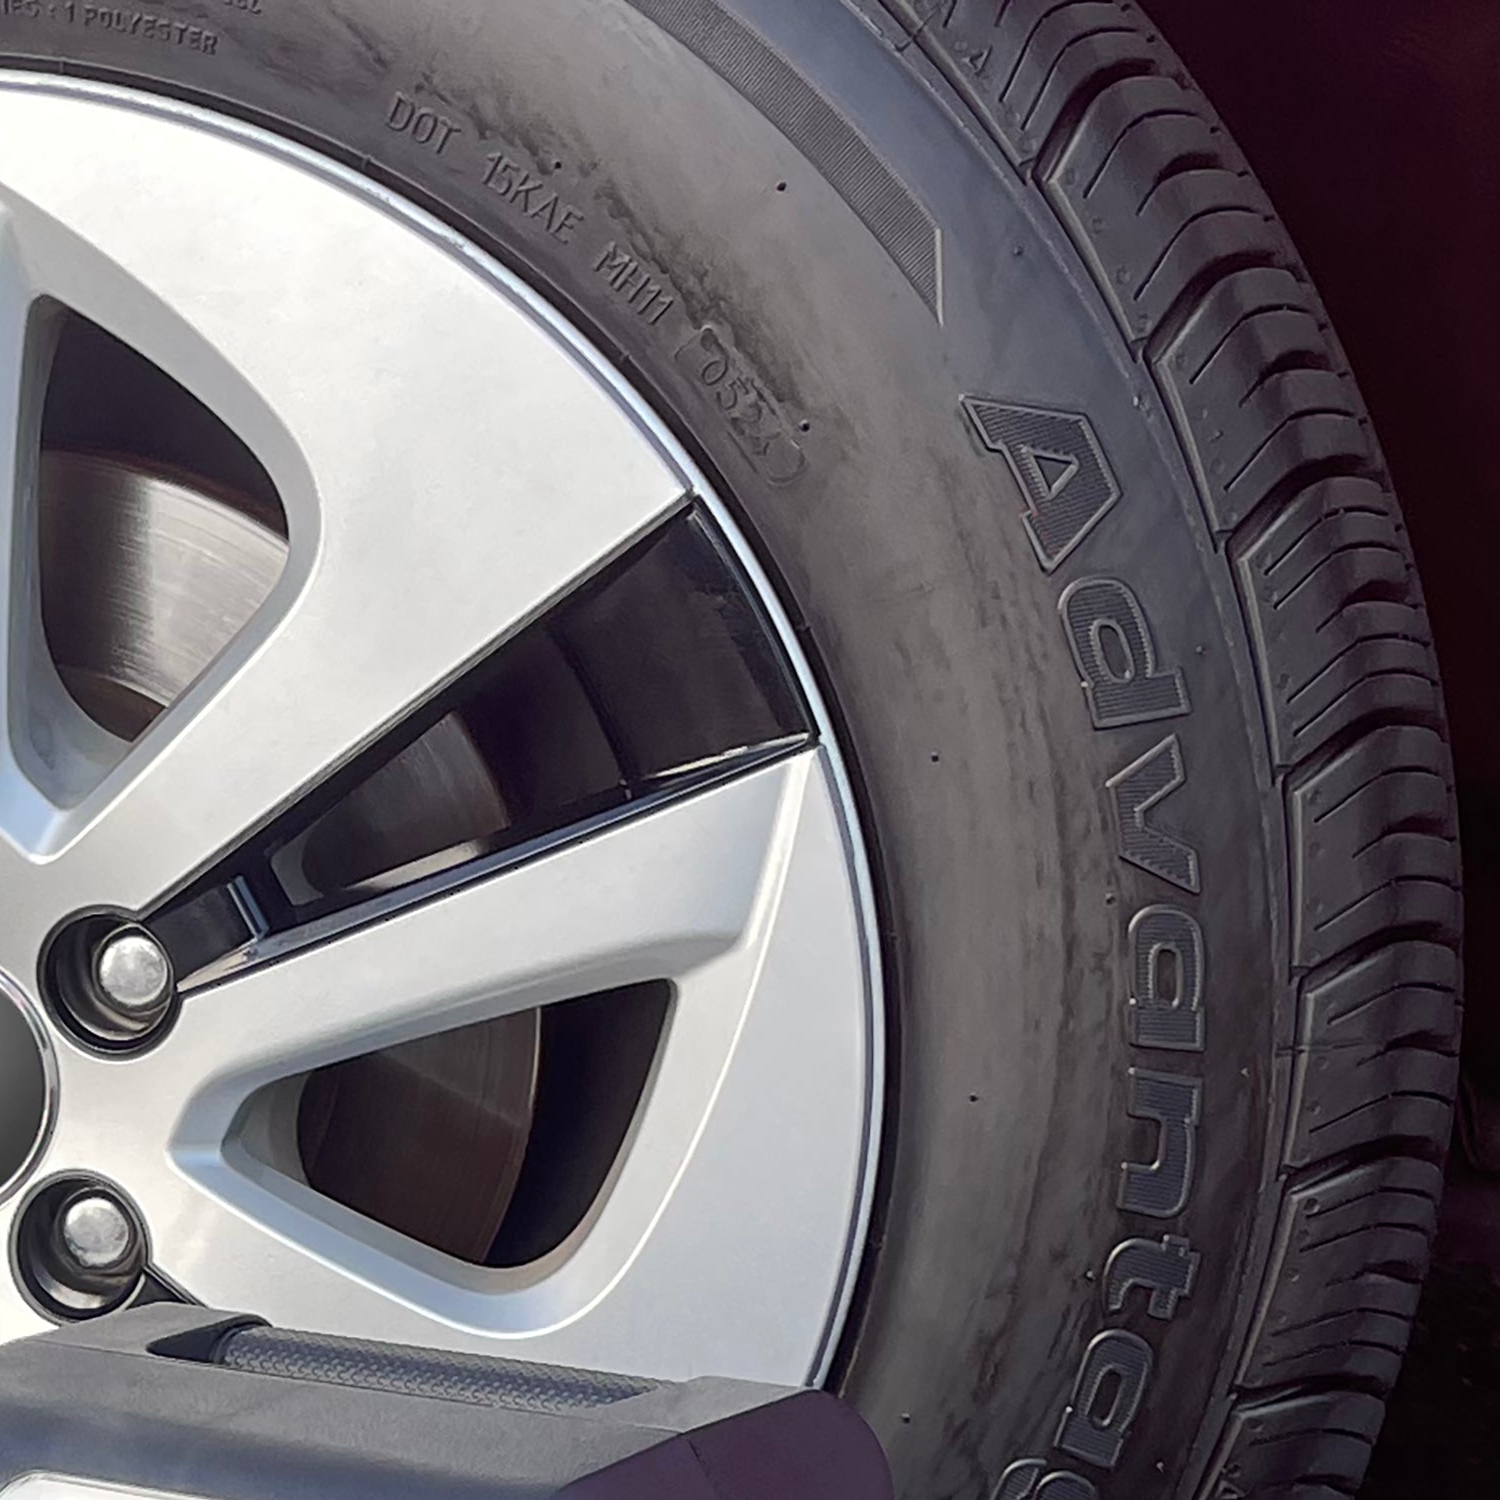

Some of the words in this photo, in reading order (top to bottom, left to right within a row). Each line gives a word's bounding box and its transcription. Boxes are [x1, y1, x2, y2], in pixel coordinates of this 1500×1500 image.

[83, 8, 220, 55] POLYESTER
[385, 91, 462, 156] DOT
[481, 151, 585, 247] 15KAE
[593, 239, 675, 327] MH11
